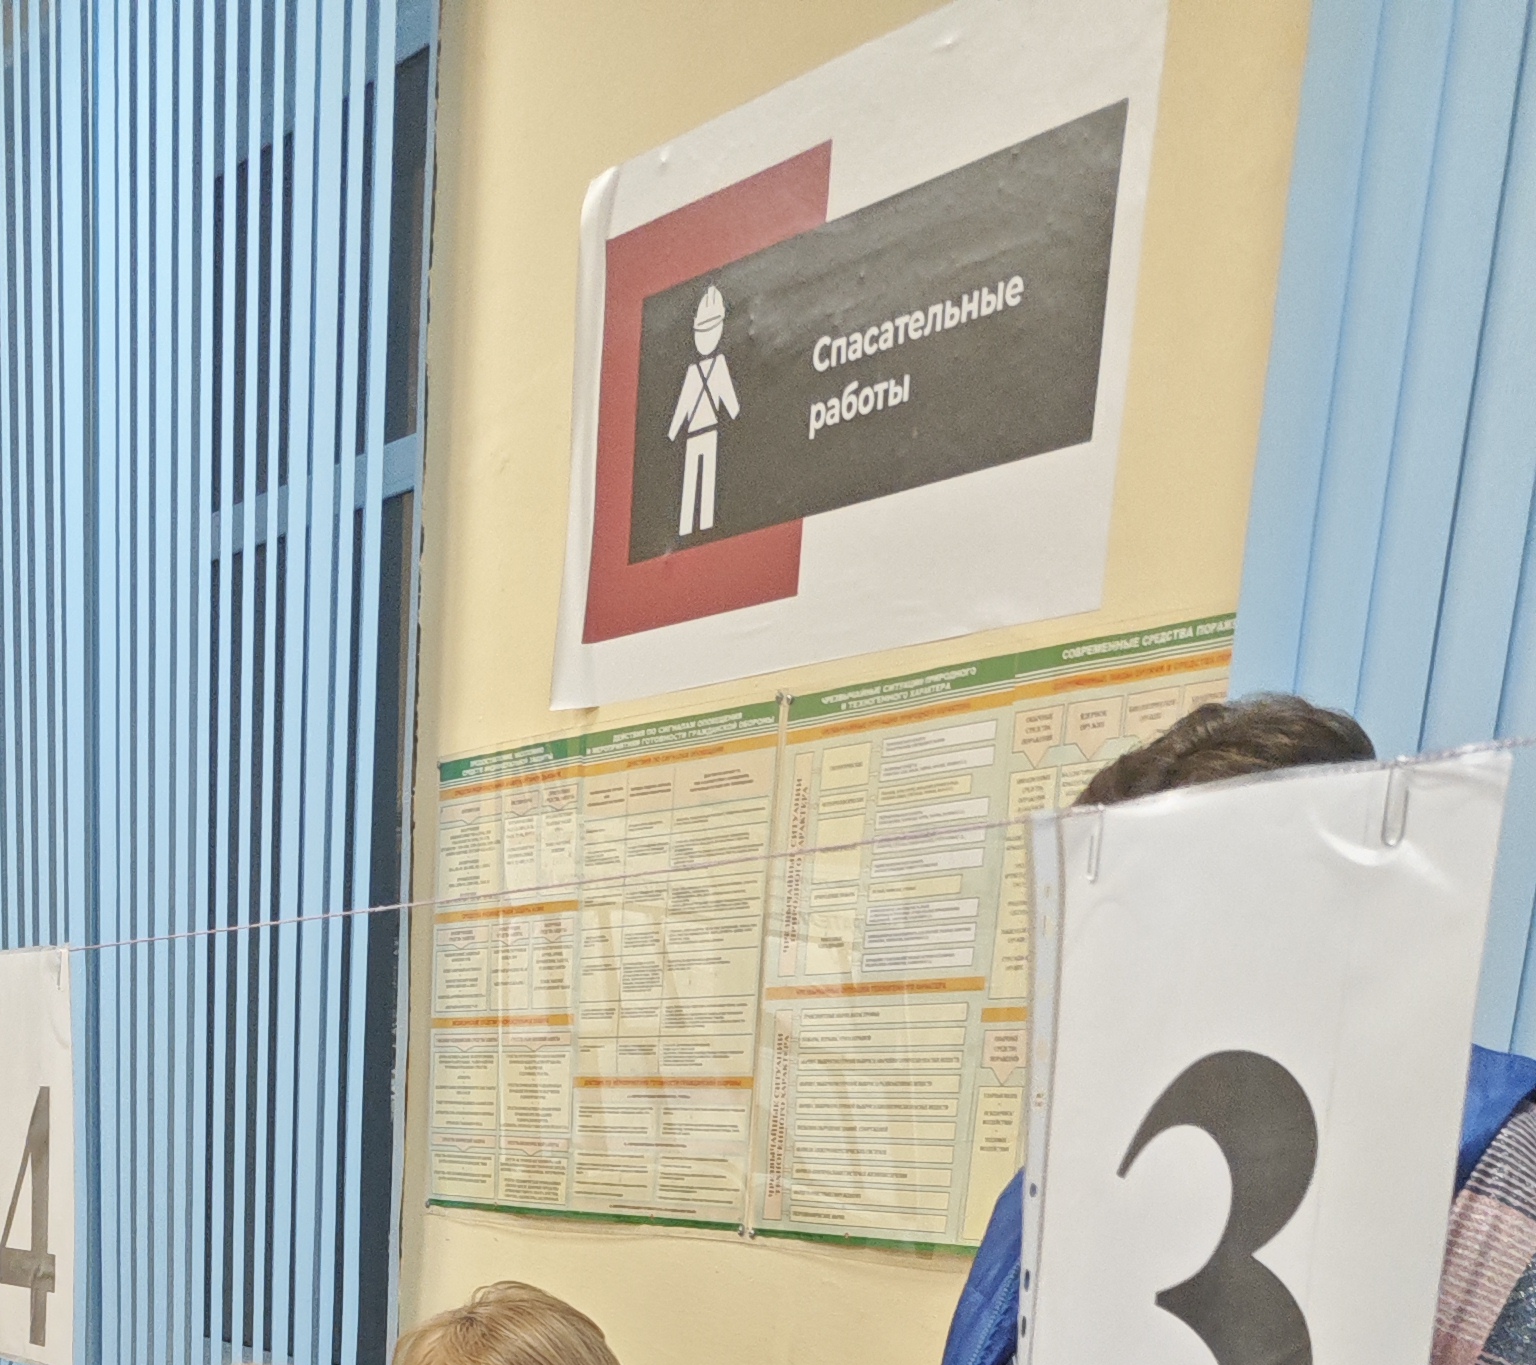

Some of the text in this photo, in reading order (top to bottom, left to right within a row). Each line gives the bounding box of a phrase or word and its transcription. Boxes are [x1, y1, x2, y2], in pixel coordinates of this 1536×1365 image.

[812, 274, 1024, 373] Спасательные
[808, 373, 910, 440] работы
[1062, 635, 1138, 660] СОВРЕМЕННЫЕ
[1142, 628, 1194, 650] СРЕДСТВА
[0, 1085, 56, 1347] 4
